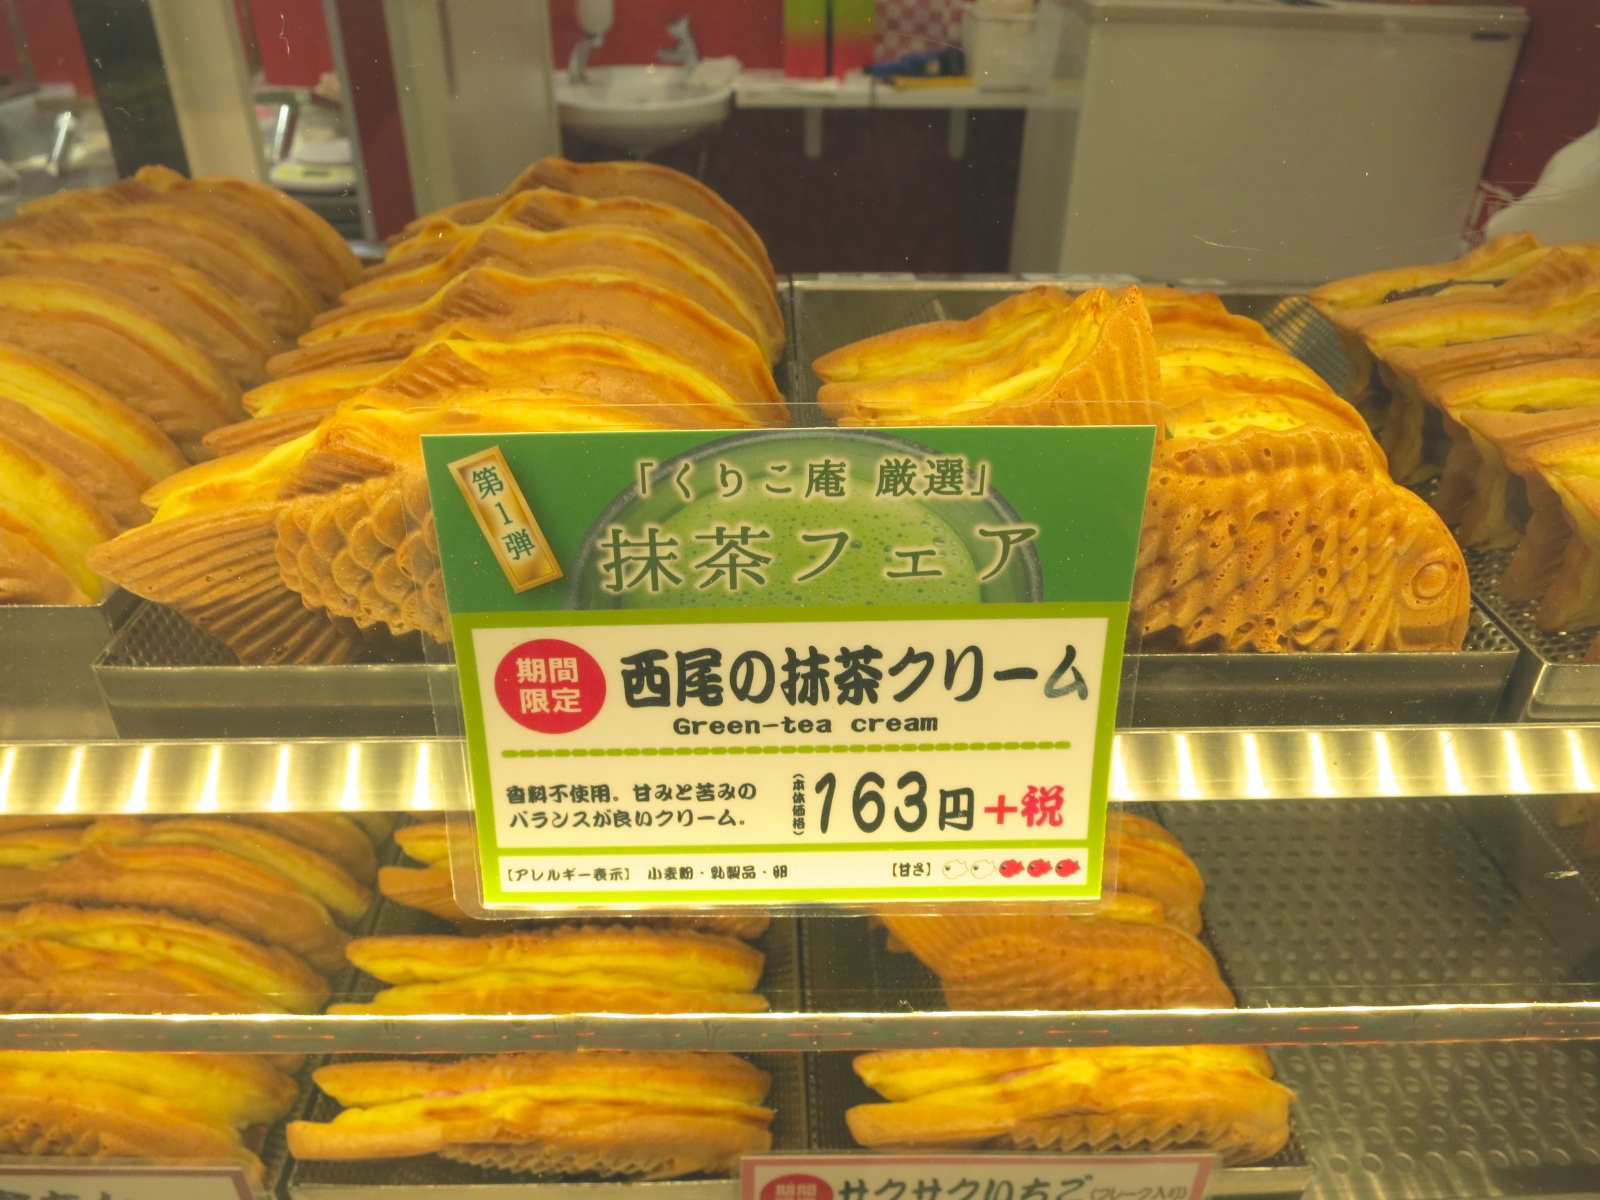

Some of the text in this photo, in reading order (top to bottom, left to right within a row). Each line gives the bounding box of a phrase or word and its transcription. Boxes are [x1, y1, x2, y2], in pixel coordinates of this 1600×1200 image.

[639, 458, 986, 499] 「くりこ庵 厳選」
[472, 465, 536, 561] 第1弾
[600, 526, 1037, 592] 抹茶フェア
[515, 656, 579, 684] 期間
[620, 644, 1089, 708] 西尾の抹茶クリーム
[519, 687, 582, 715] 限定
[673, 716, 938, 735] Green-tea cream
[509, 808, 746, 829] バランスが良いクリーム。
